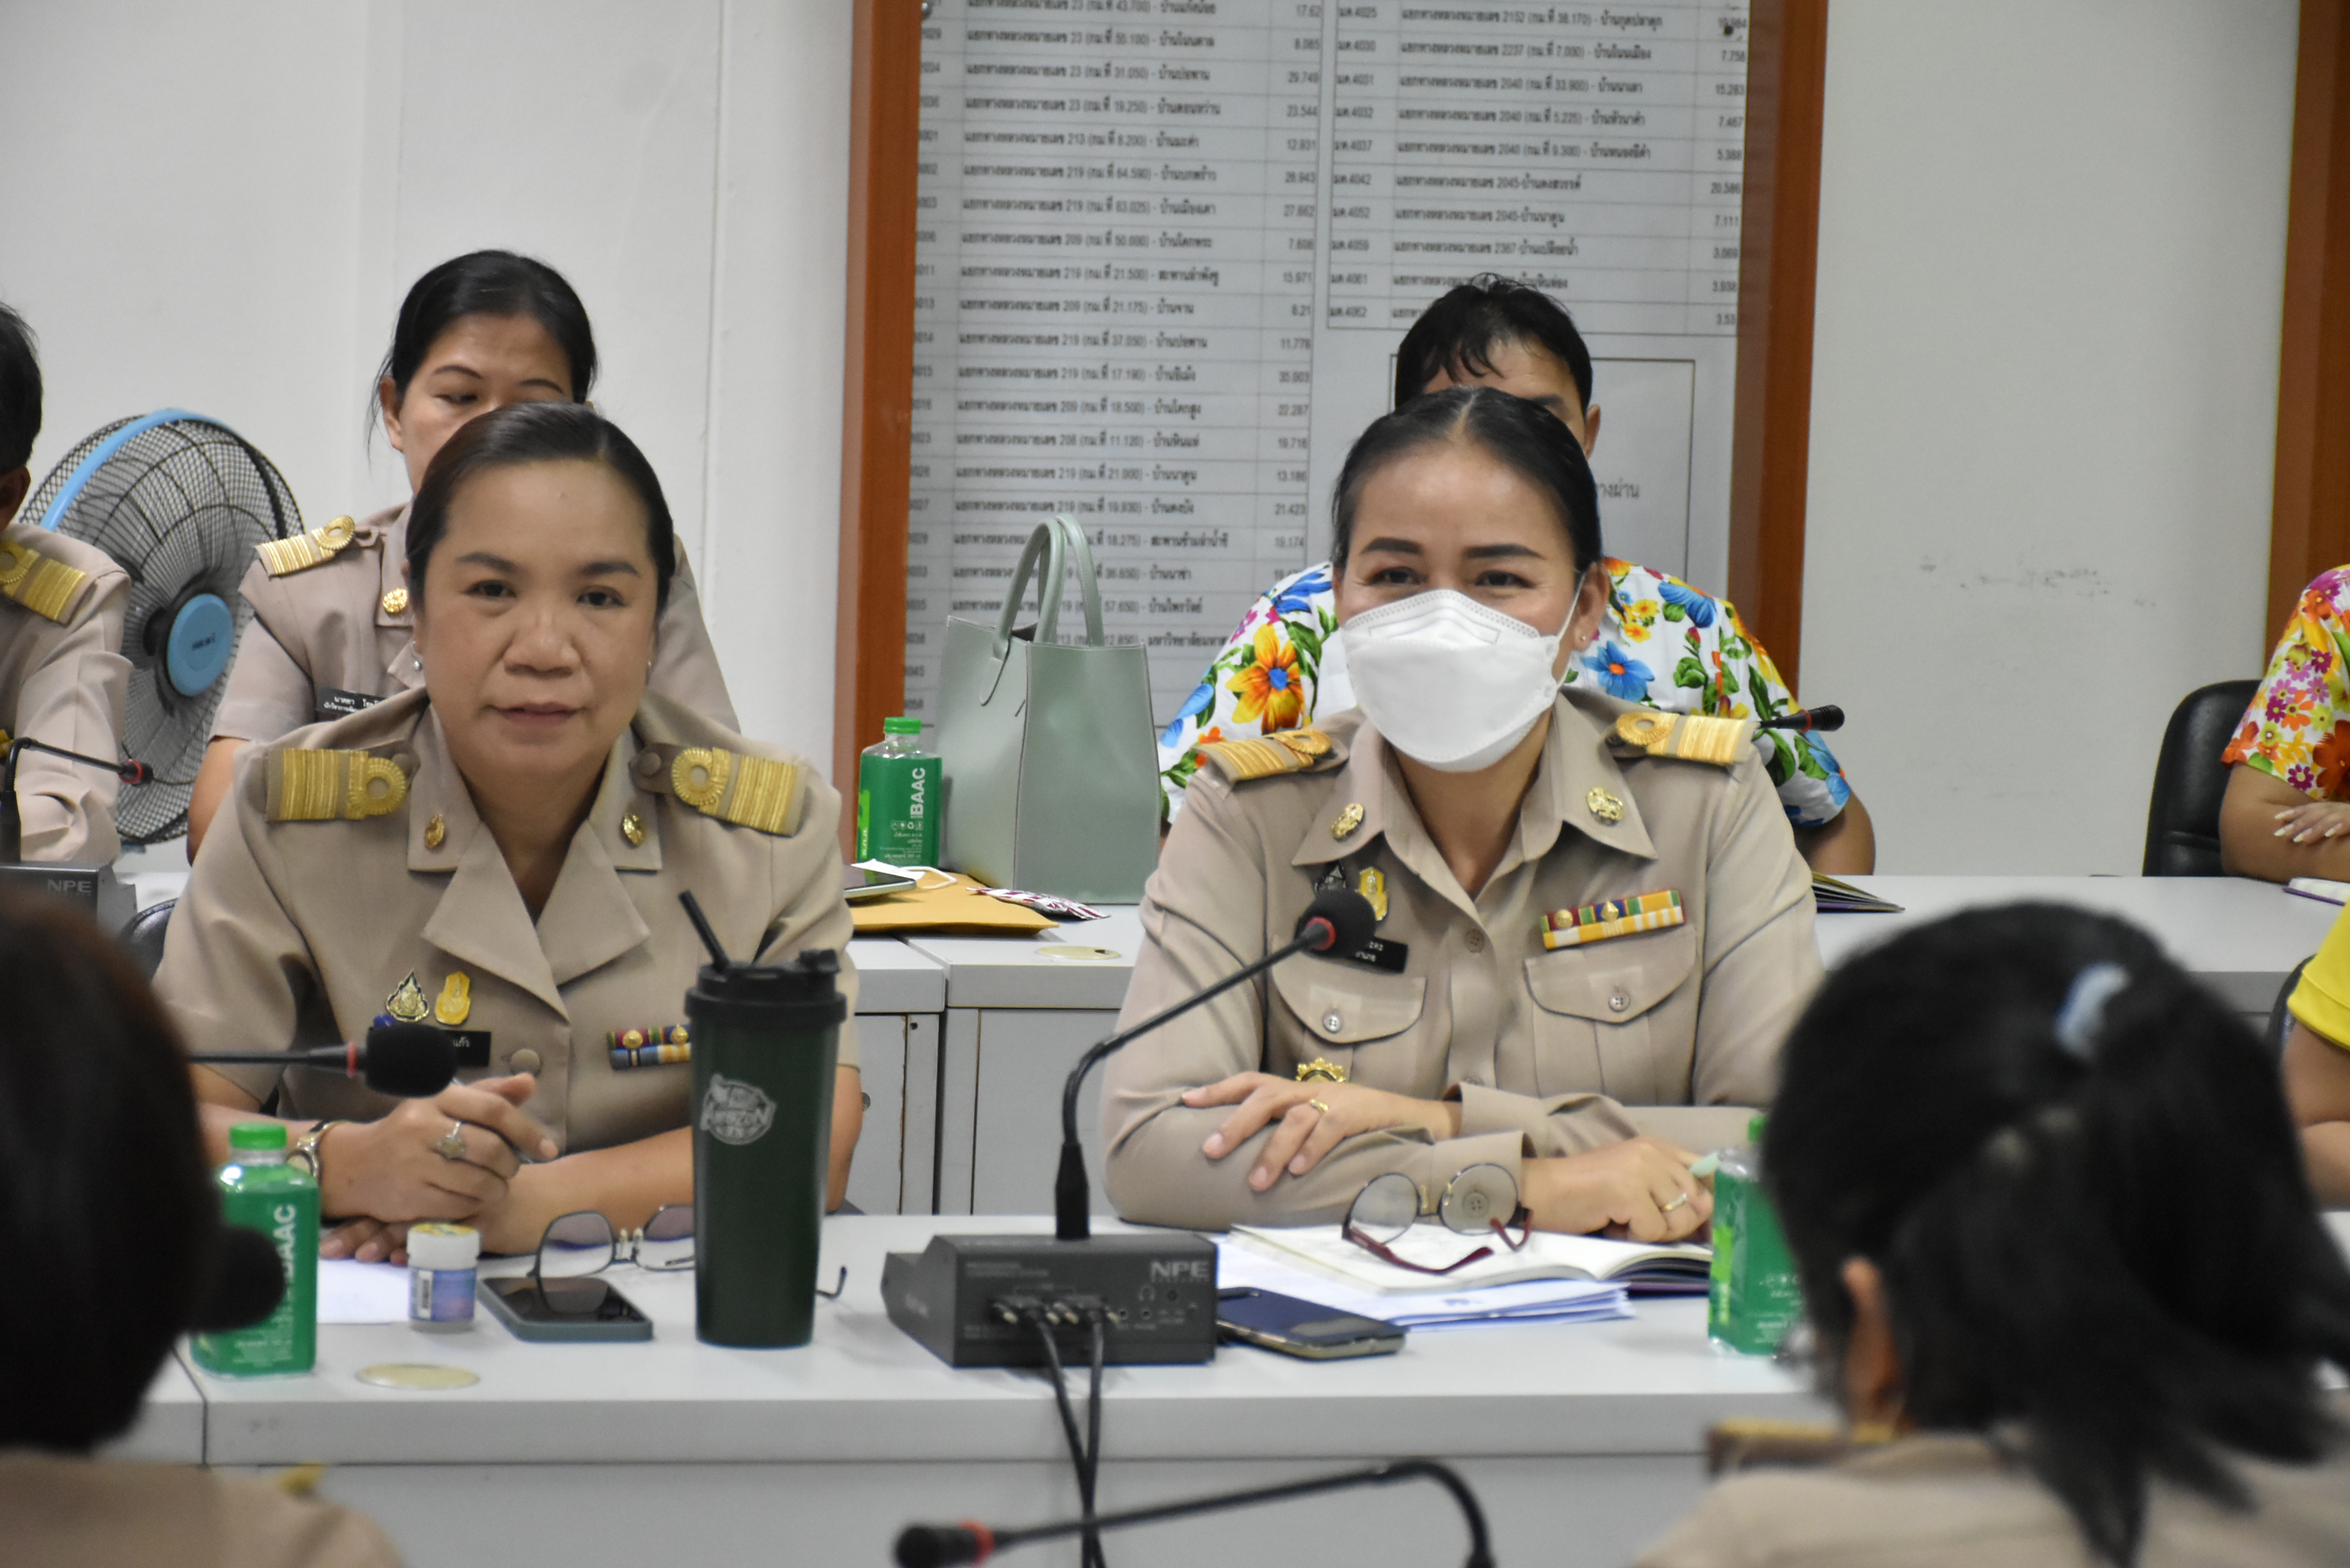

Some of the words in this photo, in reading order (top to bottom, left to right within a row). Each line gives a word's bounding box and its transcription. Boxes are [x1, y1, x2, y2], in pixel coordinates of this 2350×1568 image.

[910, 767, 926, 815] BAAC
[47, 879, 91, 893] NPE
[1151, 1260, 1209, 1278] NPE
